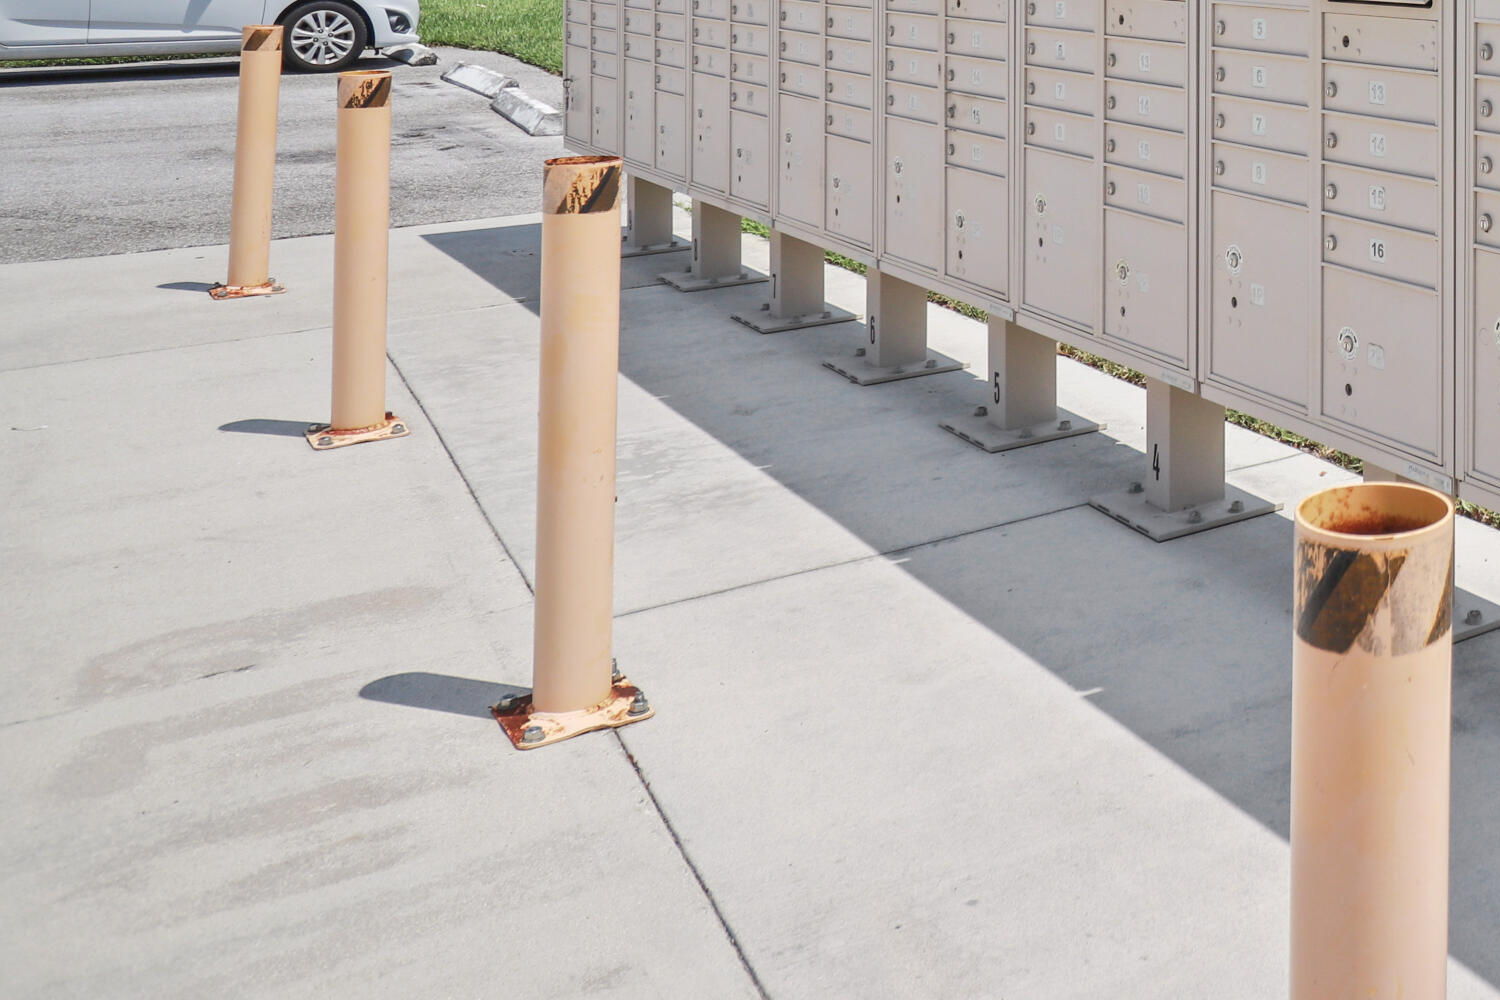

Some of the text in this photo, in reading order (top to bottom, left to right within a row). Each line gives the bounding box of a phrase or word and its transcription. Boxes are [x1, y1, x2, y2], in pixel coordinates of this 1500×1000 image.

[1256, 21, 1263, 35] 5
[1256, 70, 1262, 83] 6
[1371, 84, 1384, 101] 13
[1256, 117, 1262, 130] 7
[1371, 242, 1384, 258] 16
[772, 273, 776, 299] 7
[870, 315, 875, 344] 6
[994, 371, 1000, 404] 5
[1152, 443, 1160, 480] 4
